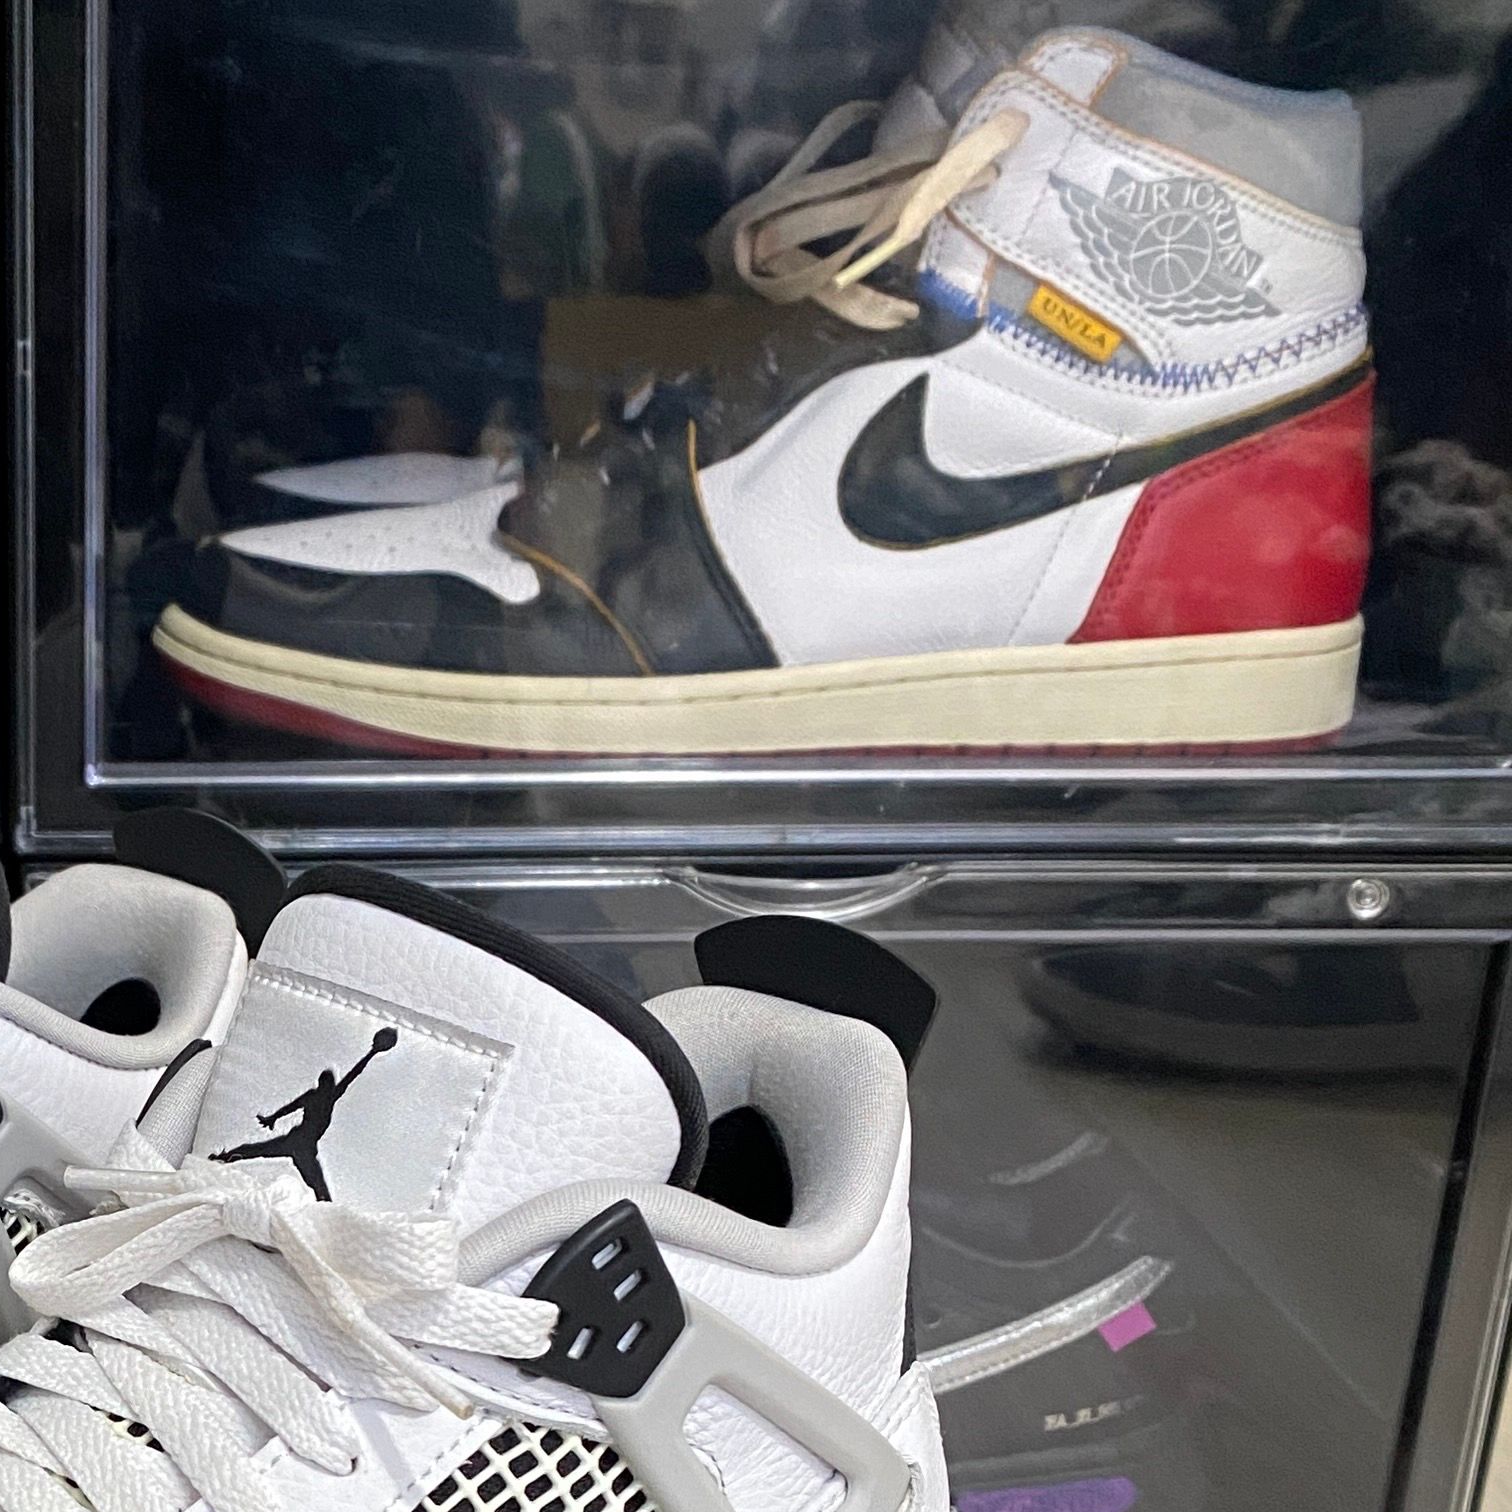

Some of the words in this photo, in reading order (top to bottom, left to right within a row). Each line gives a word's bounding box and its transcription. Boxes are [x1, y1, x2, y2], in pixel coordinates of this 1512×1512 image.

[1107, 180, 1172, 214] AIR
[1181, 178, 1260, 280] JORDAN
[1041, 297, 1108, 350] UN/LA
